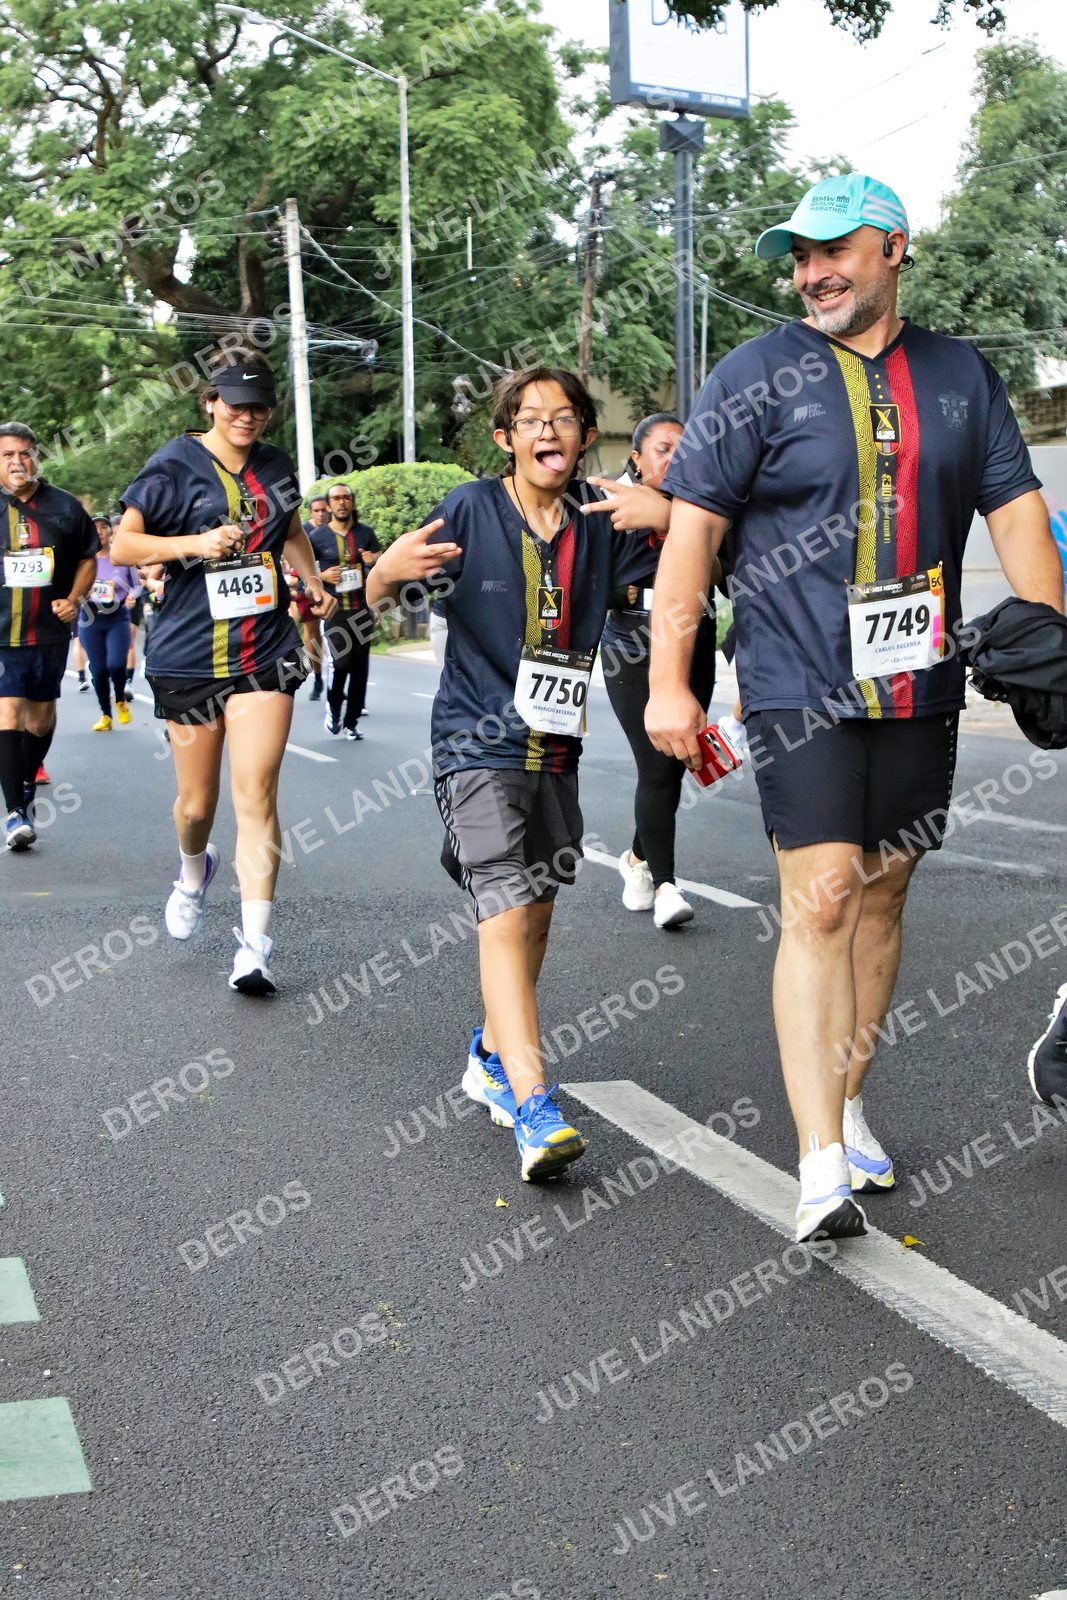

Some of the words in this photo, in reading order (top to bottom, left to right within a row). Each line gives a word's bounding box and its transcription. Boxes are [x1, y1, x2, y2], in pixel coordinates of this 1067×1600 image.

[812, 195, 836, 203] BMW
[810, 206, 848, 215] MARATHON
[11, 560, 44, 573] 7293
[217, 573, 264, 598] 4463
[865, 604, 930, 645] 7749
[874, 645, 895, 654] CARLOS
[896, 640, 922, 650] BECERRA
[529, 673, 587, 708] 7750
[532, 704, 556, 713] MAURICIO
[556, 708, 577, 717] BECERRA
